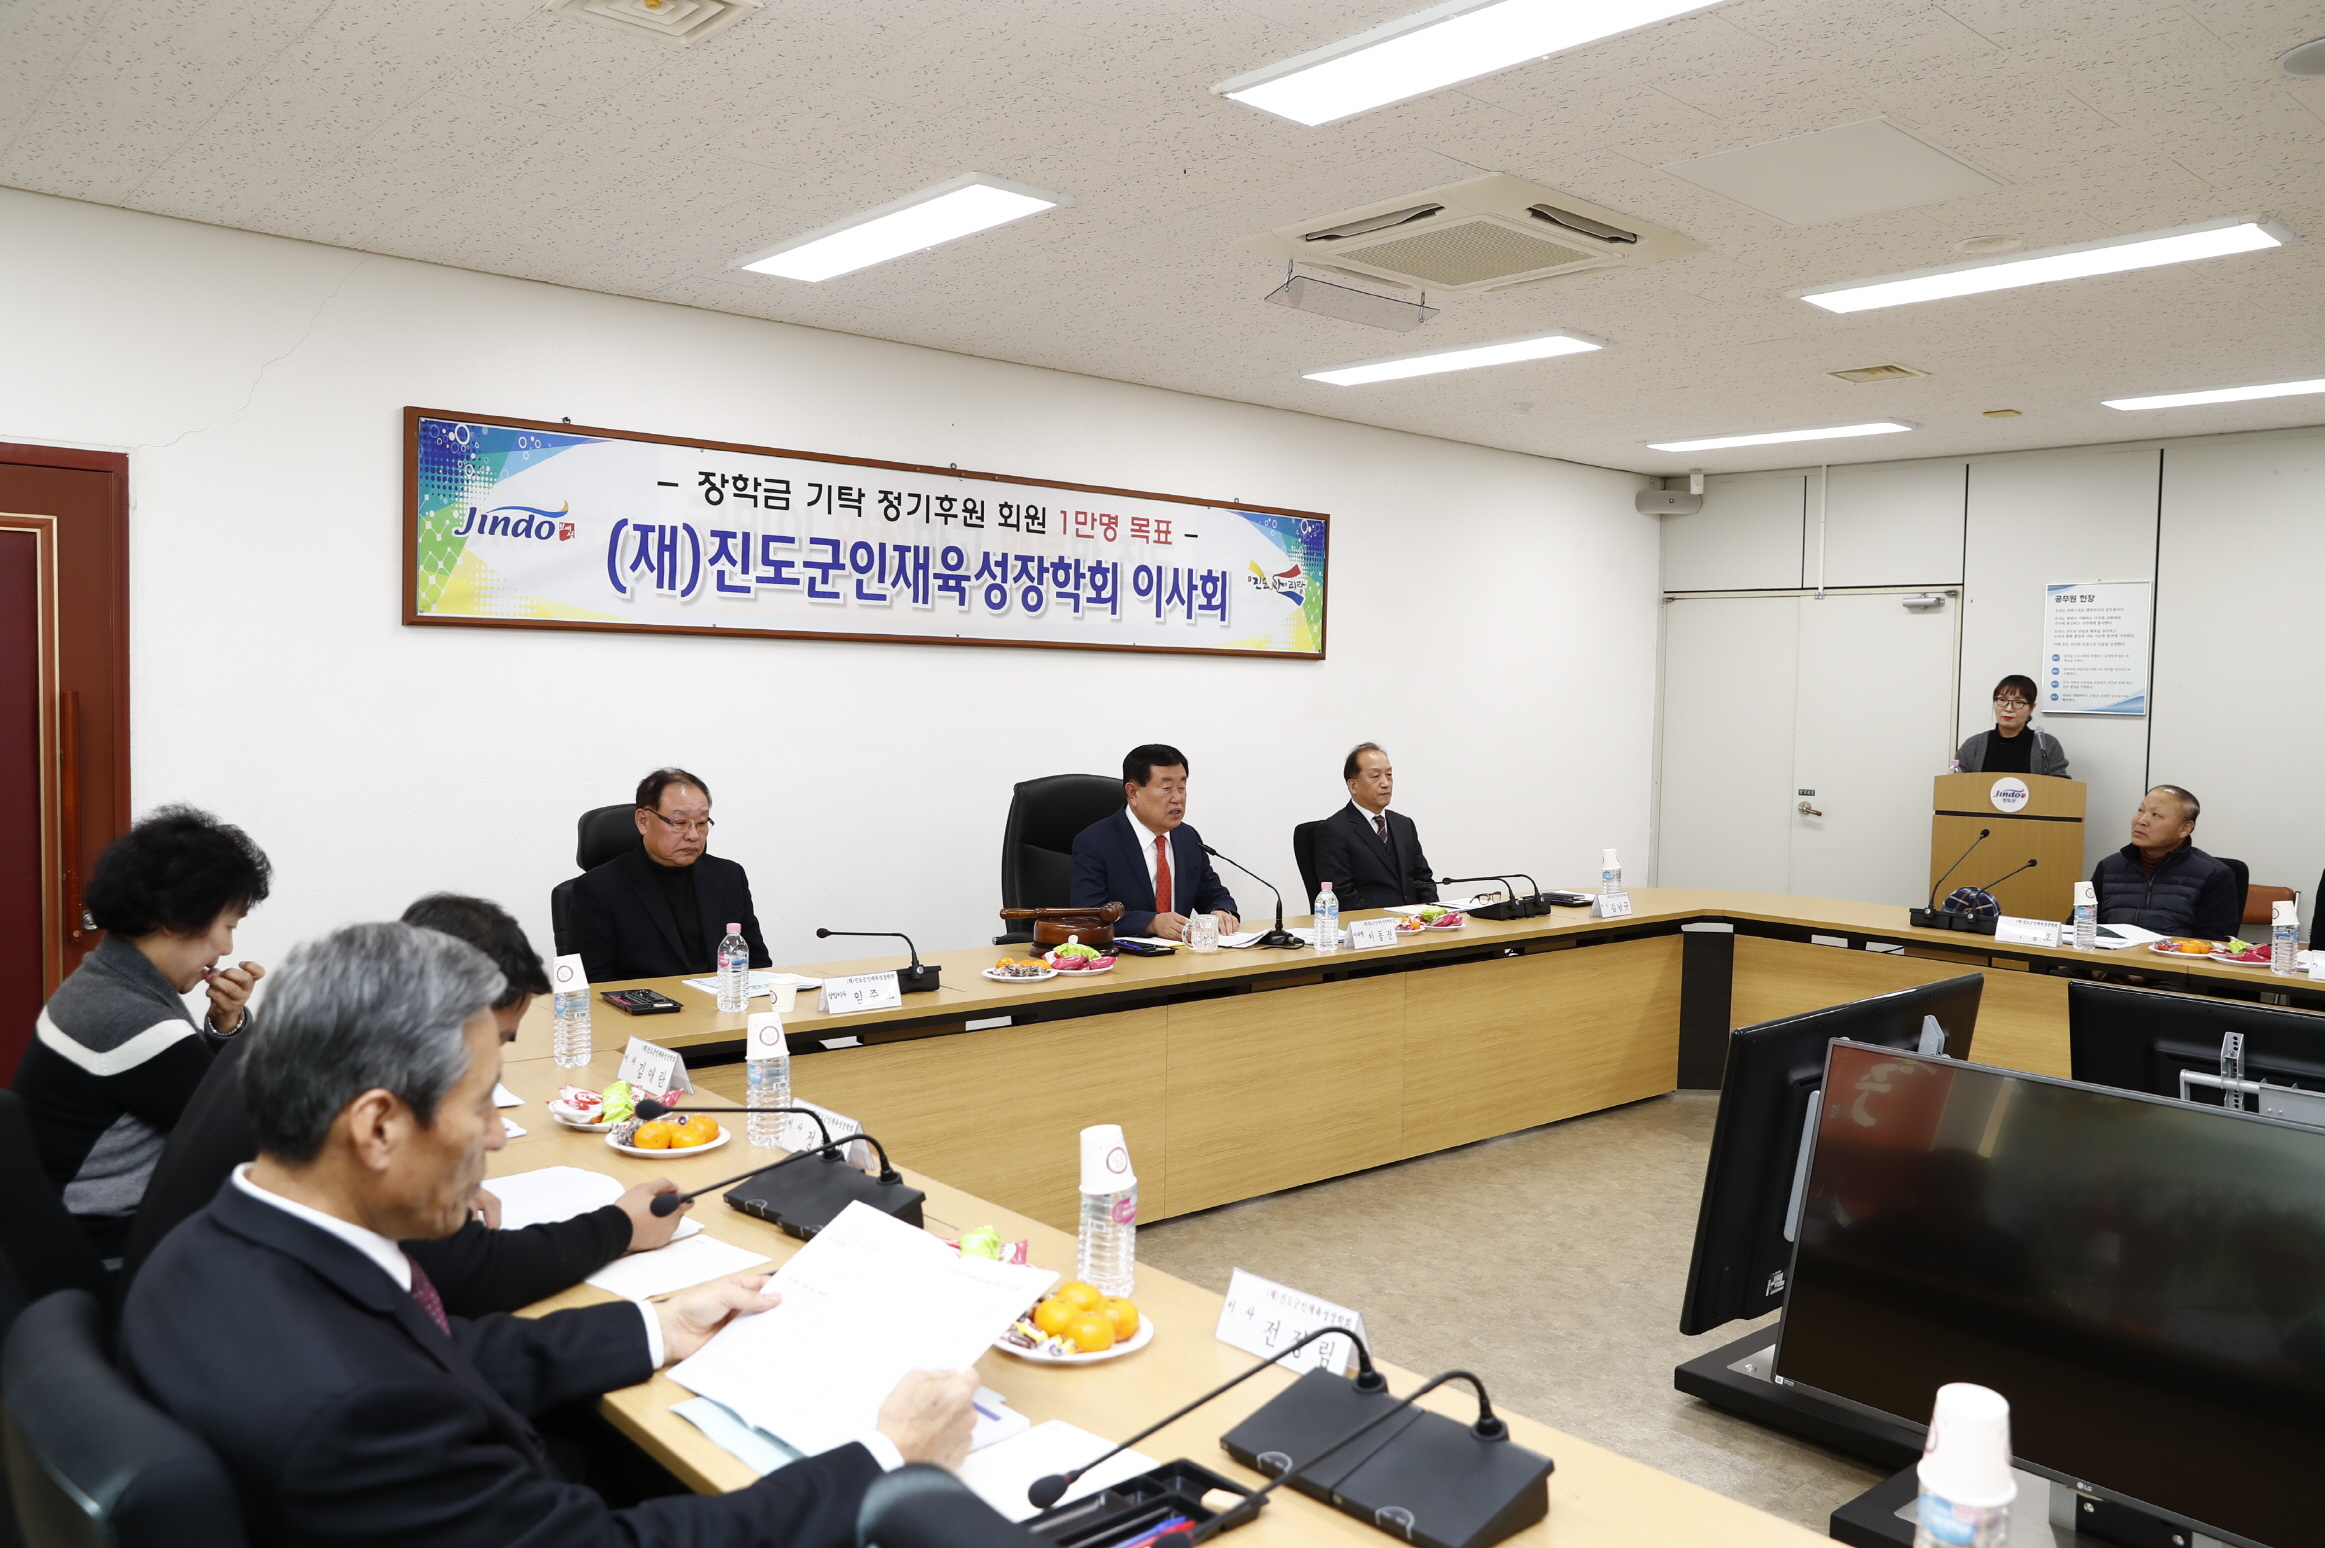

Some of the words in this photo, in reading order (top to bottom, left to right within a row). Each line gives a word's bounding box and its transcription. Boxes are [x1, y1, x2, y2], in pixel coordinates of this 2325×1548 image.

[454, 506, 556, 540] Jindo
[698, 471, 792, 511] 장학금
[807, 482, 866, 518] 기탁
[877, 489, 985, 529] 정기후원
[998, 501, 1046, 535] 회원
[1060, 510, 1119, 542] 1만명
[1130, 516, 1173, 545] 목표
[607, 518, 1118, 615] (재)진도군인재육성장학회
[1133, 564, 1227, 622] 이사회
[2054, 595, 2077, 603] 공무원
[2079, 594, 2095, 603] 헌장
[1993, 790, 2020, 798] Jindo
